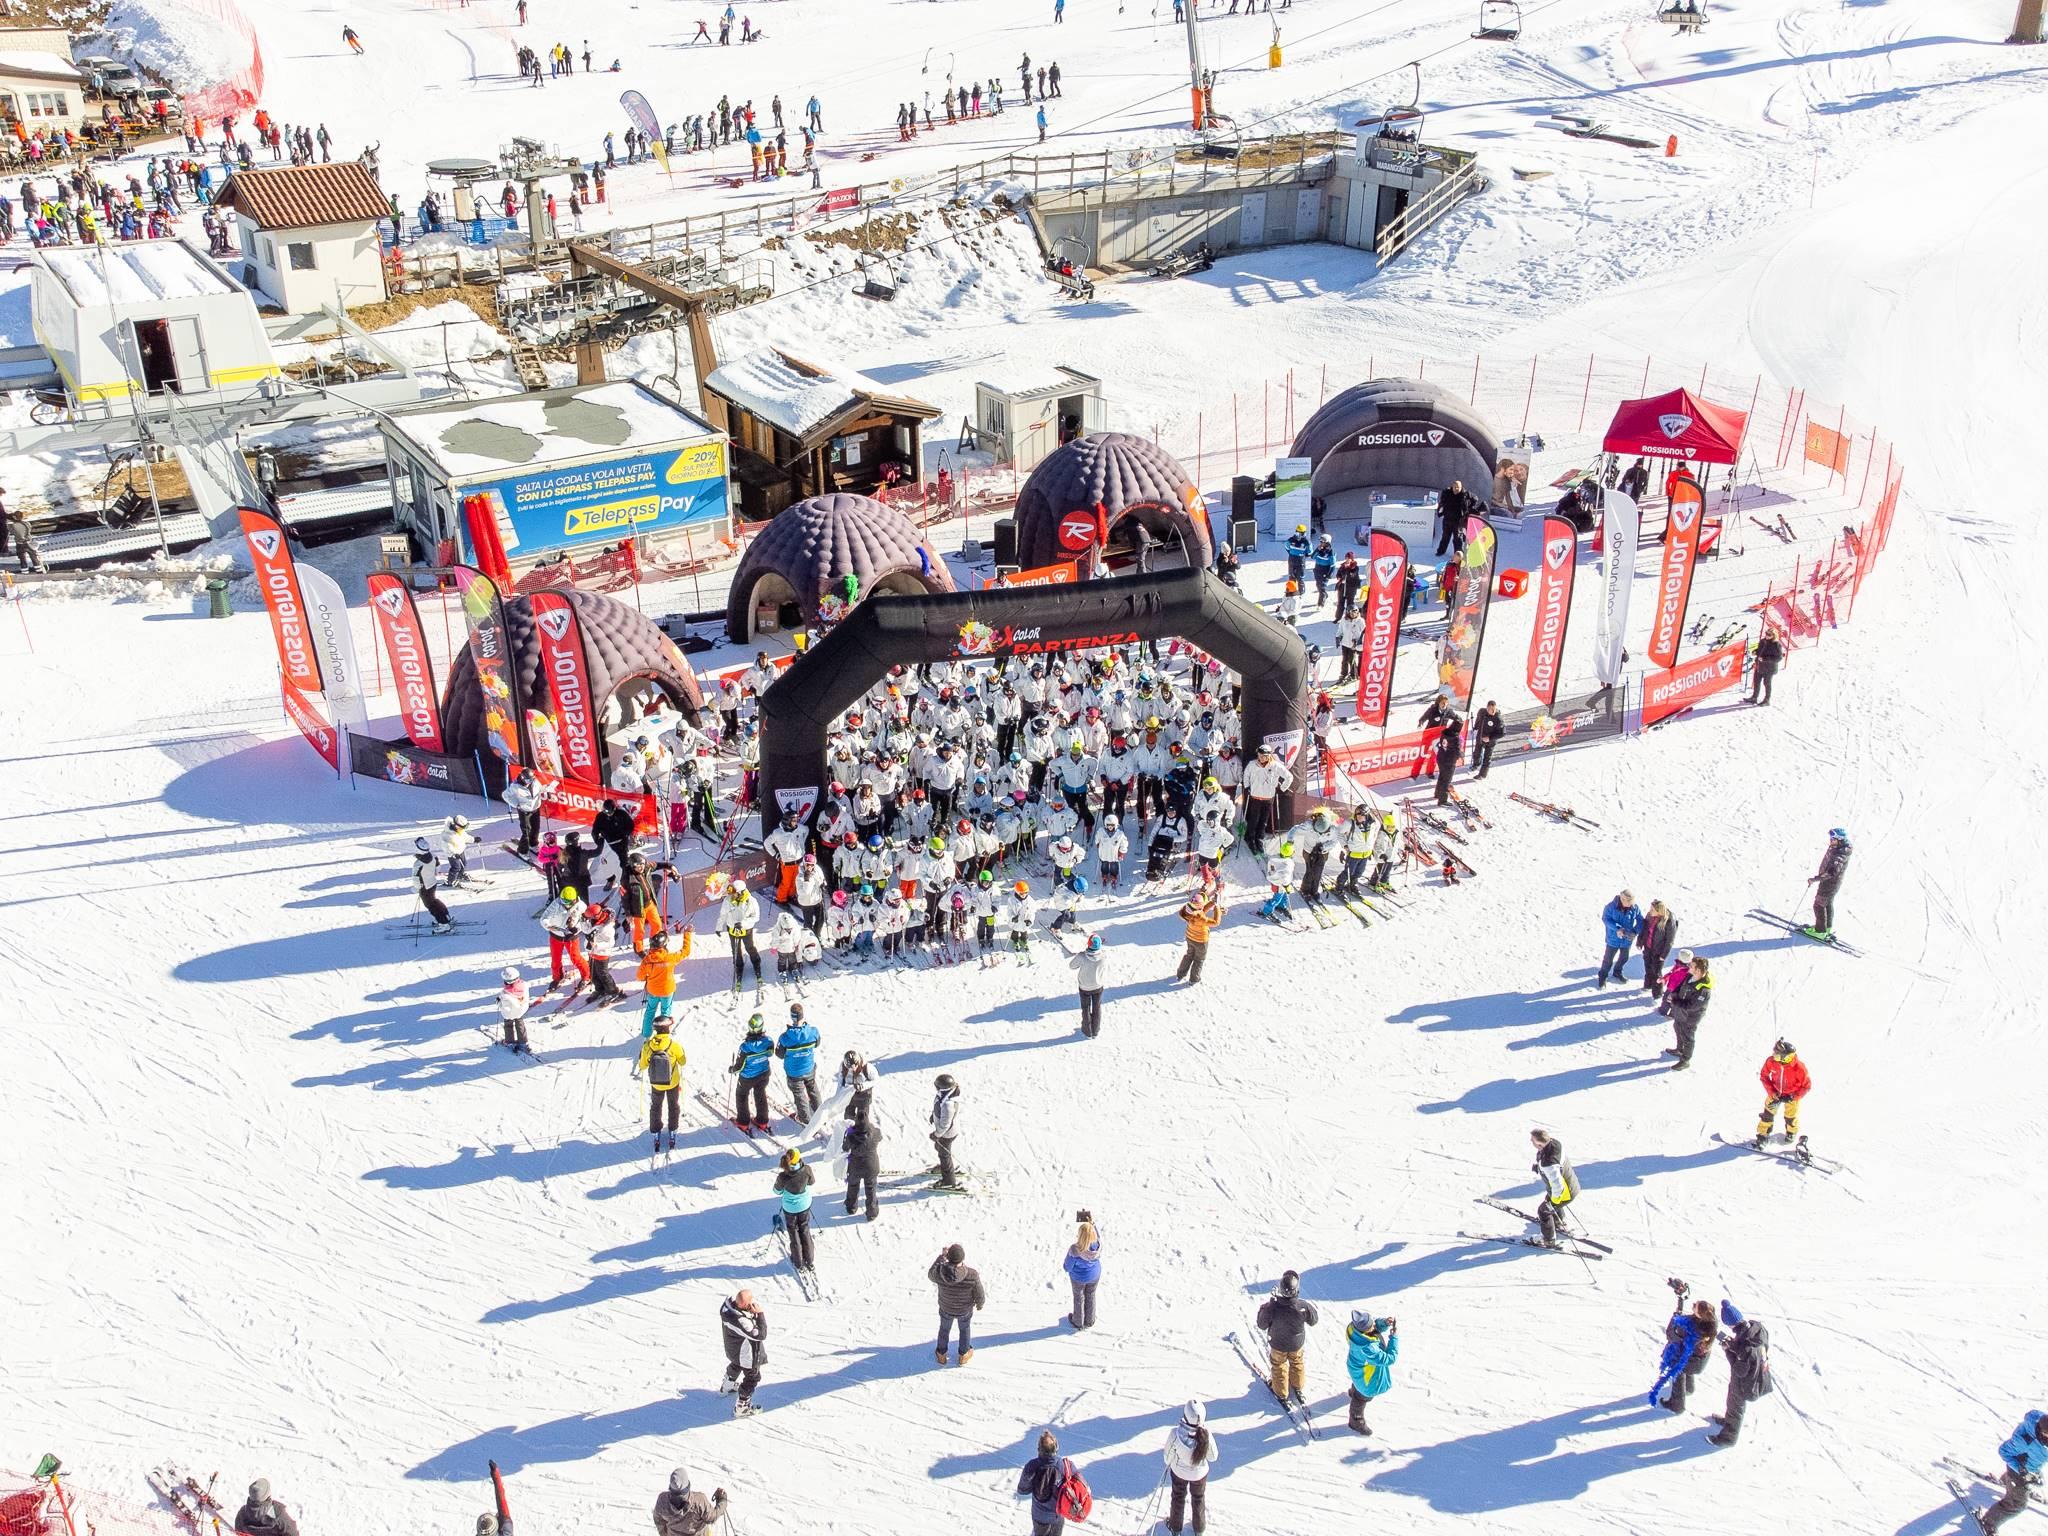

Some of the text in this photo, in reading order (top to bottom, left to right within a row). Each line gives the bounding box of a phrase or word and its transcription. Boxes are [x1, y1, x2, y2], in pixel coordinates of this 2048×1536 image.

[1358, 433, 1426, 446] ROSSIGNOL
[688, 451, 716, 462] -20%
[1641, 445, 1685, 456] ROSSIGNOL
[515, 462, 652, 493] SALTA LA CODA E VOLA IN VETTA
[516, 471, 656, 503] CON LO SKIPASS TELEPASS PAY.
[582, 495, 695, 525] Telepass Pay
[1013, 627, 1041, 642] COLOR
[1012, 632, 1141, 655] PARTENZA
[1652, 666, 1716, 704] ROSSIGNOL
[1572, 714, 1595, 730] COLOR
[427, 767, 448, 780] COLOR
[780, 790, 815, 798] ROSSIGNOL
[745, 862, 767, 880] COLOR
